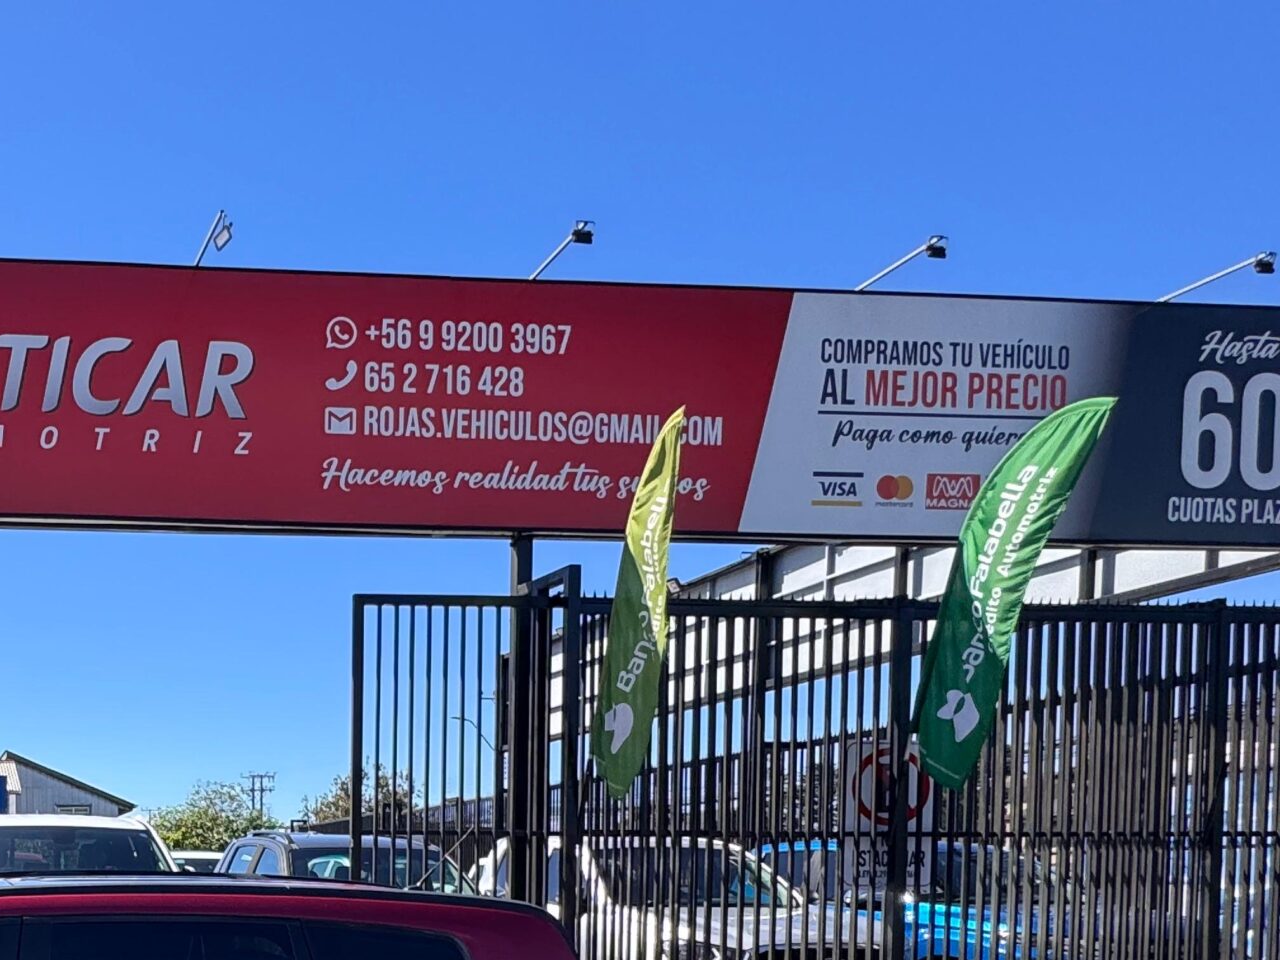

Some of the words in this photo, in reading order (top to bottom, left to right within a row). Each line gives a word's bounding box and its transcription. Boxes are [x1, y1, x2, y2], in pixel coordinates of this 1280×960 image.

[365, 317, 412, 349] +56
[419, 319, 434, 350] 9
[441, 321, 503, 352] 9200
[510, 323, 572, 354] 3967
[1198, 330, 1280, 365] Hasta
[820, 338, 943, 366] COMPRAMOS
[949, 342, 972, 367] TU
[979, 339, 1070, 370] VEHÍCULO
[364, 361, 395, 392] 65
[402, 362, 417, 393] 2
[425, 363, 470, 395] 716
[477, 366, 524, 397] 428
[820, 368, 855, 405] AL
[865, 369, 957, 408] MEJOR
[968, 372, 1067, 411] PRECIO
[363, 405, 723, 446] ROJAS.VEHICULOS@GMAILCOM
[832, 419, 894, 450] Paga
[899, 428, 956, 444] como
[962, 425, 1026, 452] quier
[1181, 370, 1280, 491] 60
[321, 457, 450, 494] Hacemos
[453, 460, 569, 491] realidad
[570, 462, 613, 499] tus
[617, 475, 711, 501] suos
[818, 481, 857, 497] VISA
[926, 498, 971, 508] MAGN
[1167, 496, 1236, 523] CUOTAS
[970, 465, 1039, 598] Falabella
[997, 466, 1059, 577] Automotriz
